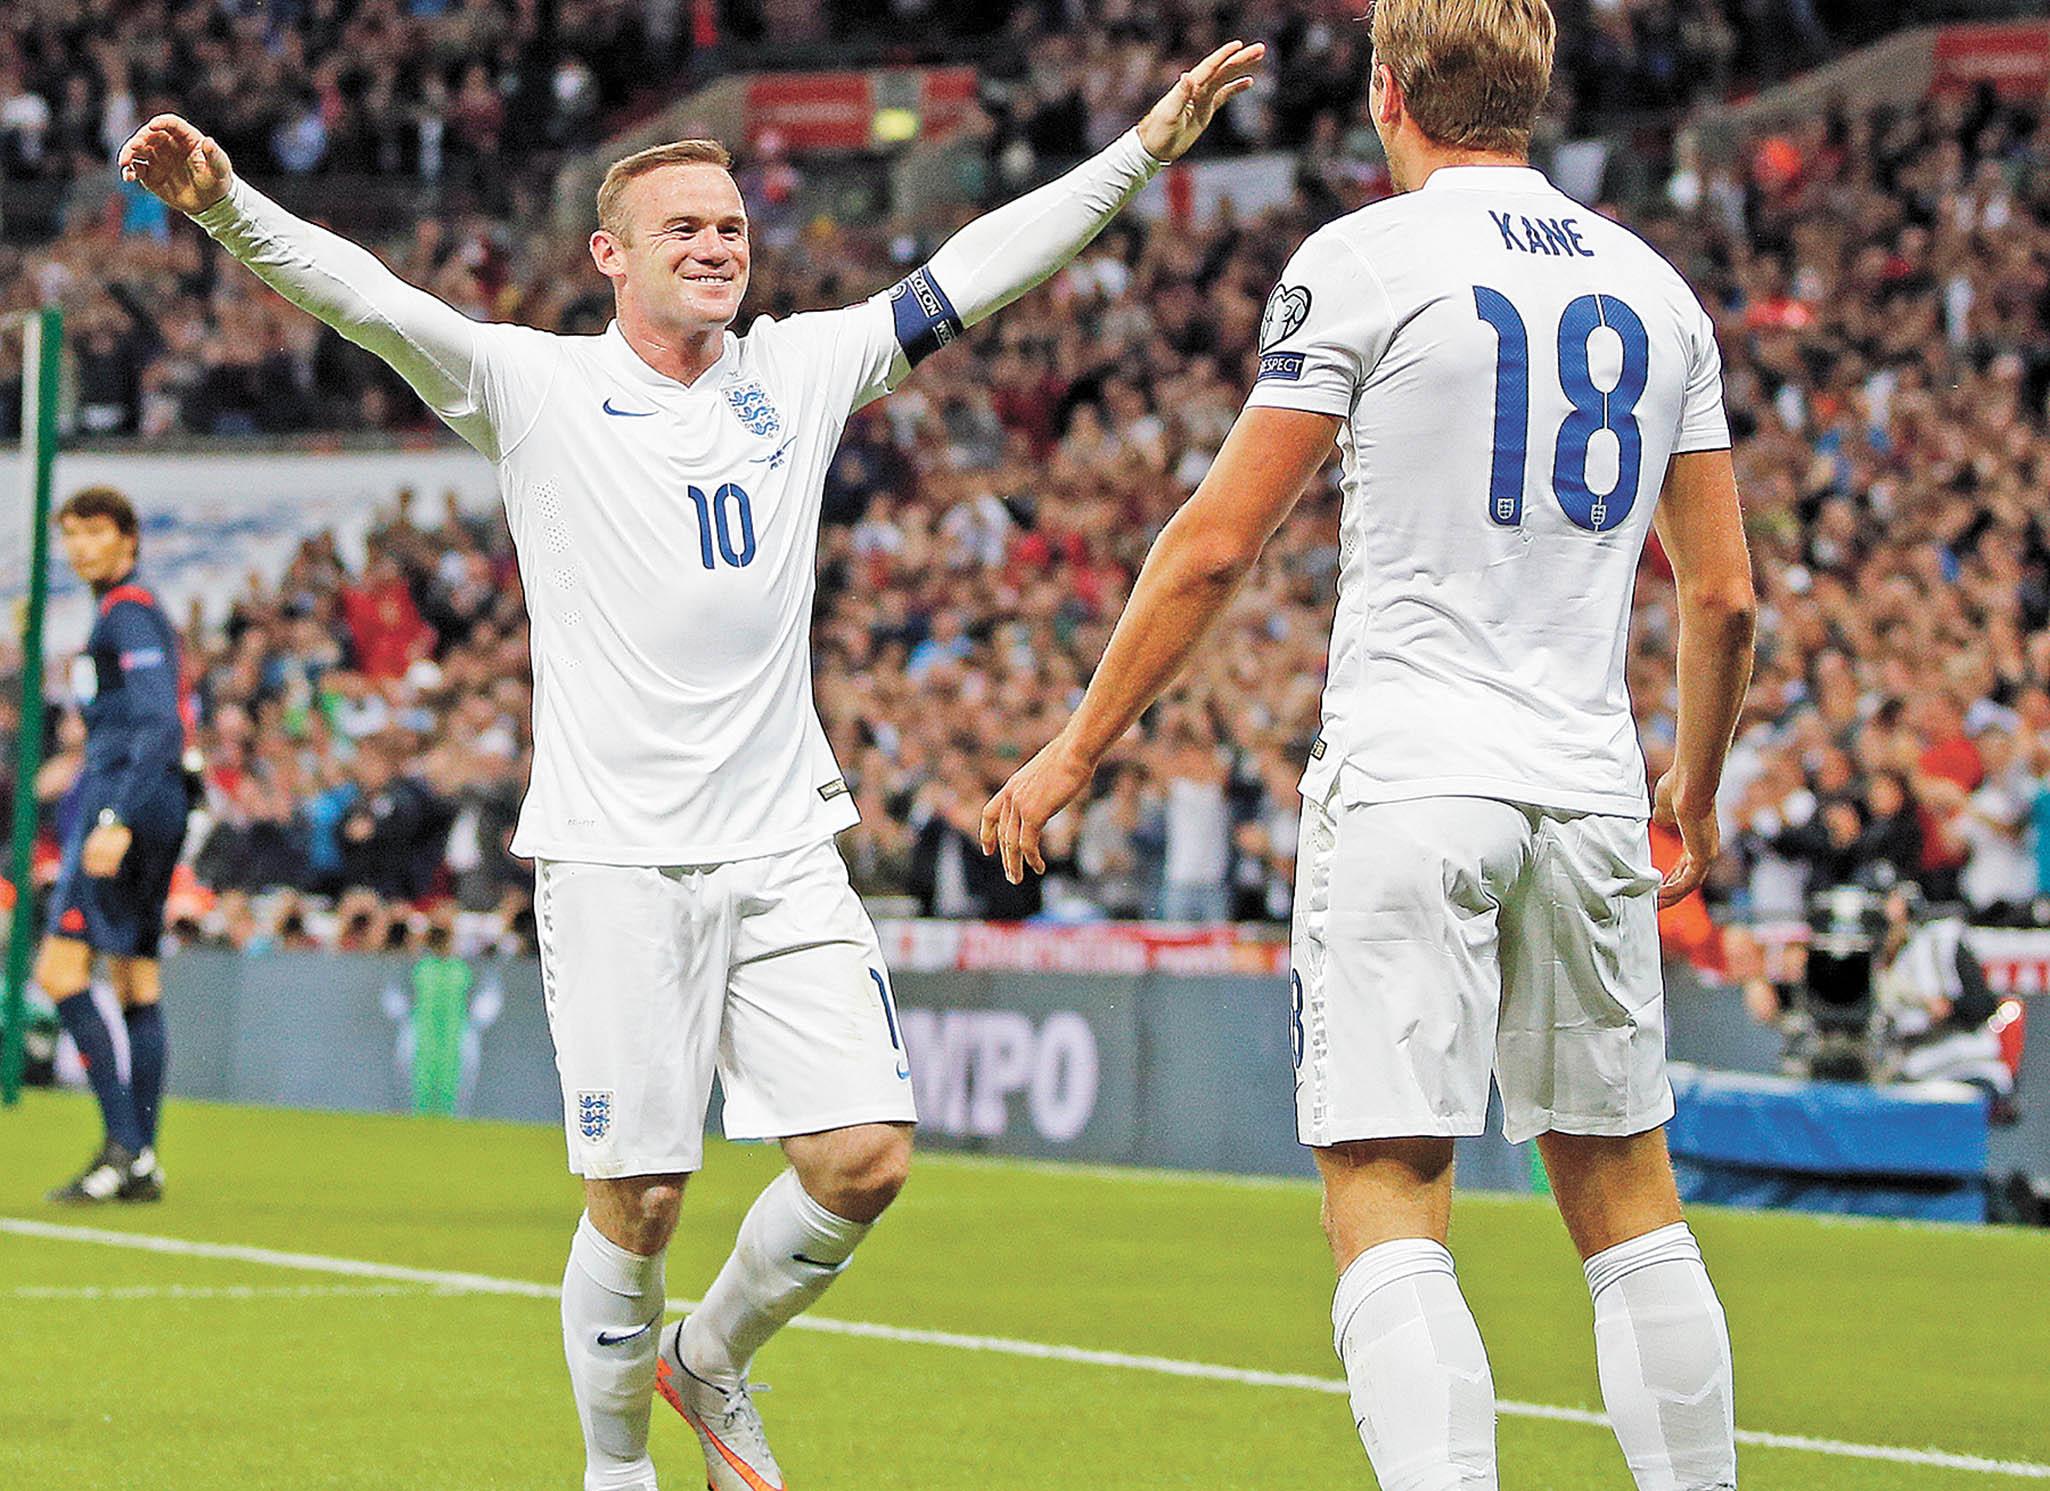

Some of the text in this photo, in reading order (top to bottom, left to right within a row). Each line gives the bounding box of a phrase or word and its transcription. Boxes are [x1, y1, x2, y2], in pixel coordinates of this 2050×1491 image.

[1488, 210, 1595, 257] KANE
[1260, 358, 1303, 373] ESPECT
[1473, 286, 1649, 532] 18
[687, 482, 756, 570] 10
